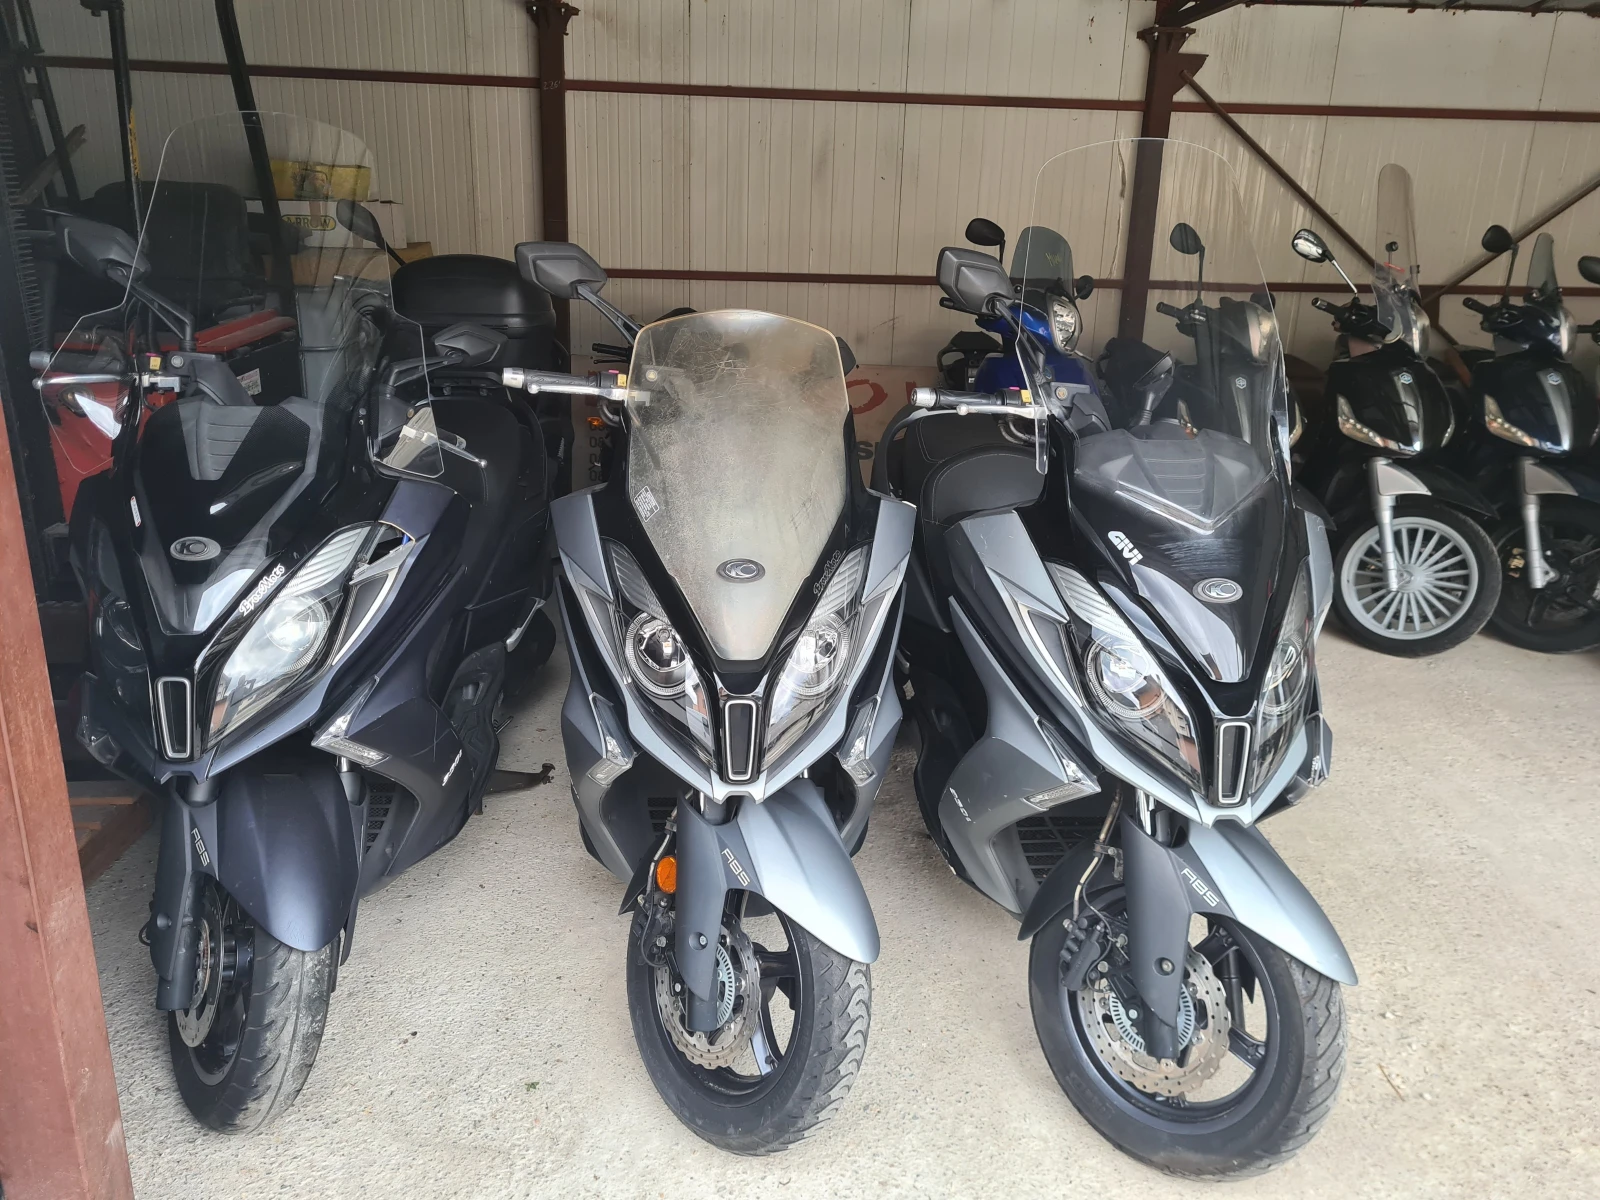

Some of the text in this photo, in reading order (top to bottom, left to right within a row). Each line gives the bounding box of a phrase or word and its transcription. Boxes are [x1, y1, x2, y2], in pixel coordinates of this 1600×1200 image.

[1107, 530, 1144, 566] GIVI
[190, 827, 210, 867] ABS
[721, 847, 751, 887] ABS
[1180, 867, 1220, 907] ABS
